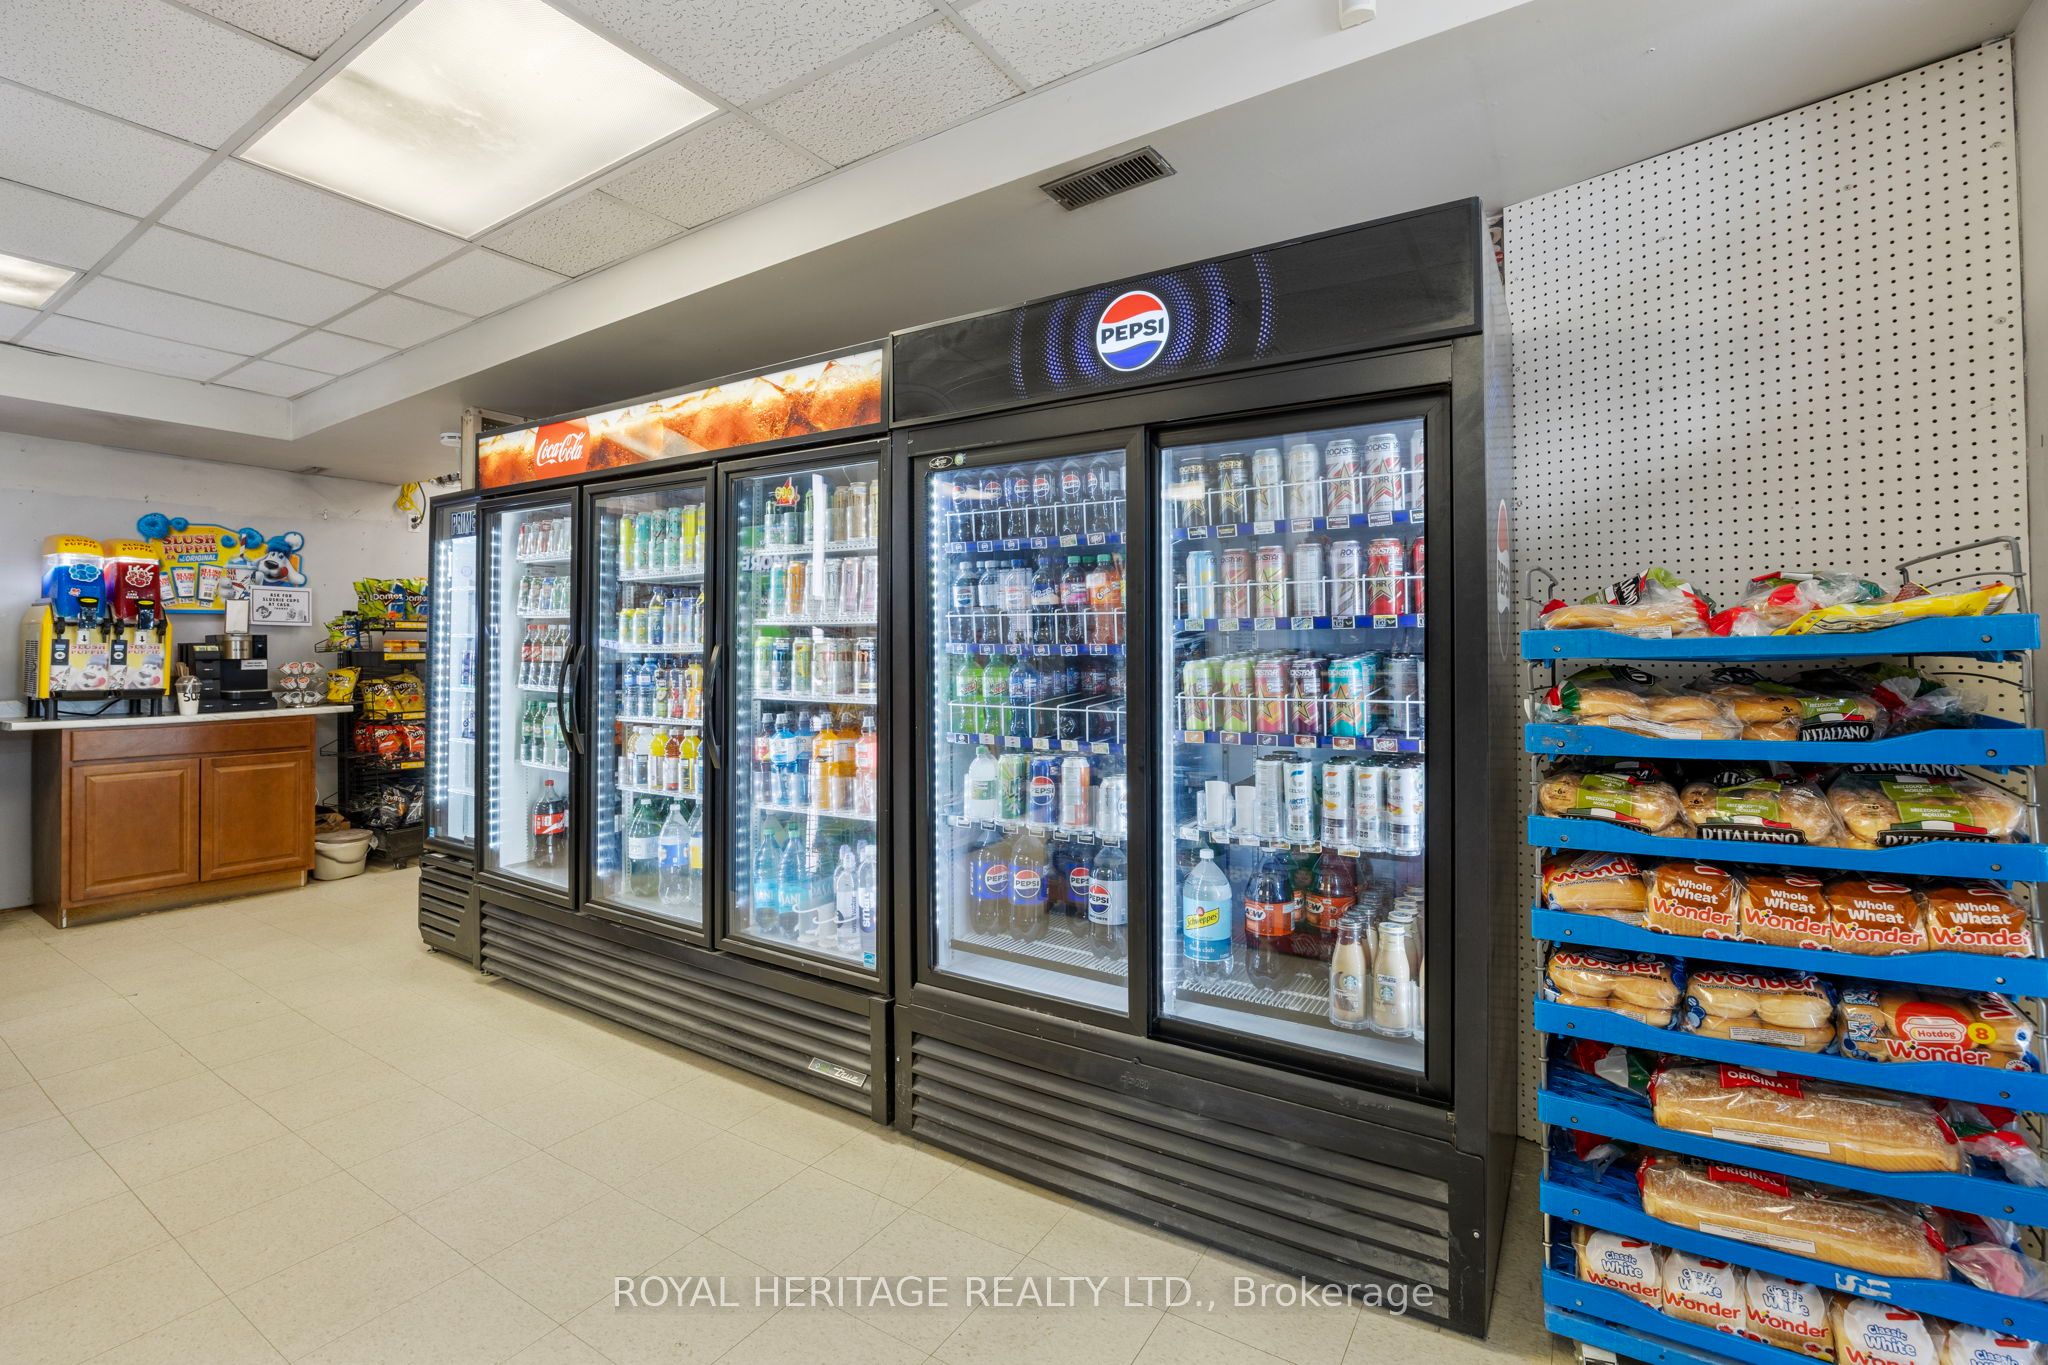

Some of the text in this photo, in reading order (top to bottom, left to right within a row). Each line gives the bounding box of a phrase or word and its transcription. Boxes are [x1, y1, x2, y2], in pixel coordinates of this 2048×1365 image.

[1101, 317, 1164, 344] PEPSI
[536, 431, 586, 466] Coca-Cola
[451, 510, 476, 536] PRIME
[163, 534, 216, 545] SLUSH
[1803, 725, 1870, 742] D'ITALIANO
[986, 874, 1008, 883] PEPS
[1678, 878, 1713, 893] Whole
[1671, 886, 1719, 904] Wheat
[1770, 889, 1809, 902] Whole
[1653, 897, 1733, 926] Wonder
[1764, 897, 1816, 914] Wheat
[1853, 900, 1895, 912] Whole
[1955, 902, 2000, 913] Whole
[1745, 908, 1830, 936] Wonder
[1848, 908, 1904, 924] Wheat
[1950, 911, 2011, 925] Wheat
[1830, 921, 1923, 946] Wonder
[1554, 953, 1665, 975] Wonder
[1695, 971, 1819, 991] Wonder
[1916, 1029, 1957, 1040] Hotdog
[1975, 1027, 1989, 1039] 8
[1887, 1039, 1990, 1066] Wonder
[1605, 1251, 1638, 1265] Classic
[1601, 1258, 1644, 1279] White
[1587, 1269, 1661, 1297] Wonder
[1664, 1289, 1741, 1319] Wonder
[1746, 1305, 1829, 1338] Wonder
[1867, 1324, 1908, 1340] Classic
[1864, 1334, 1917, 1356] White
[1845, 1346, 1916, 1365] Wond
[1975, 1350, 2019, 1365] Classic
